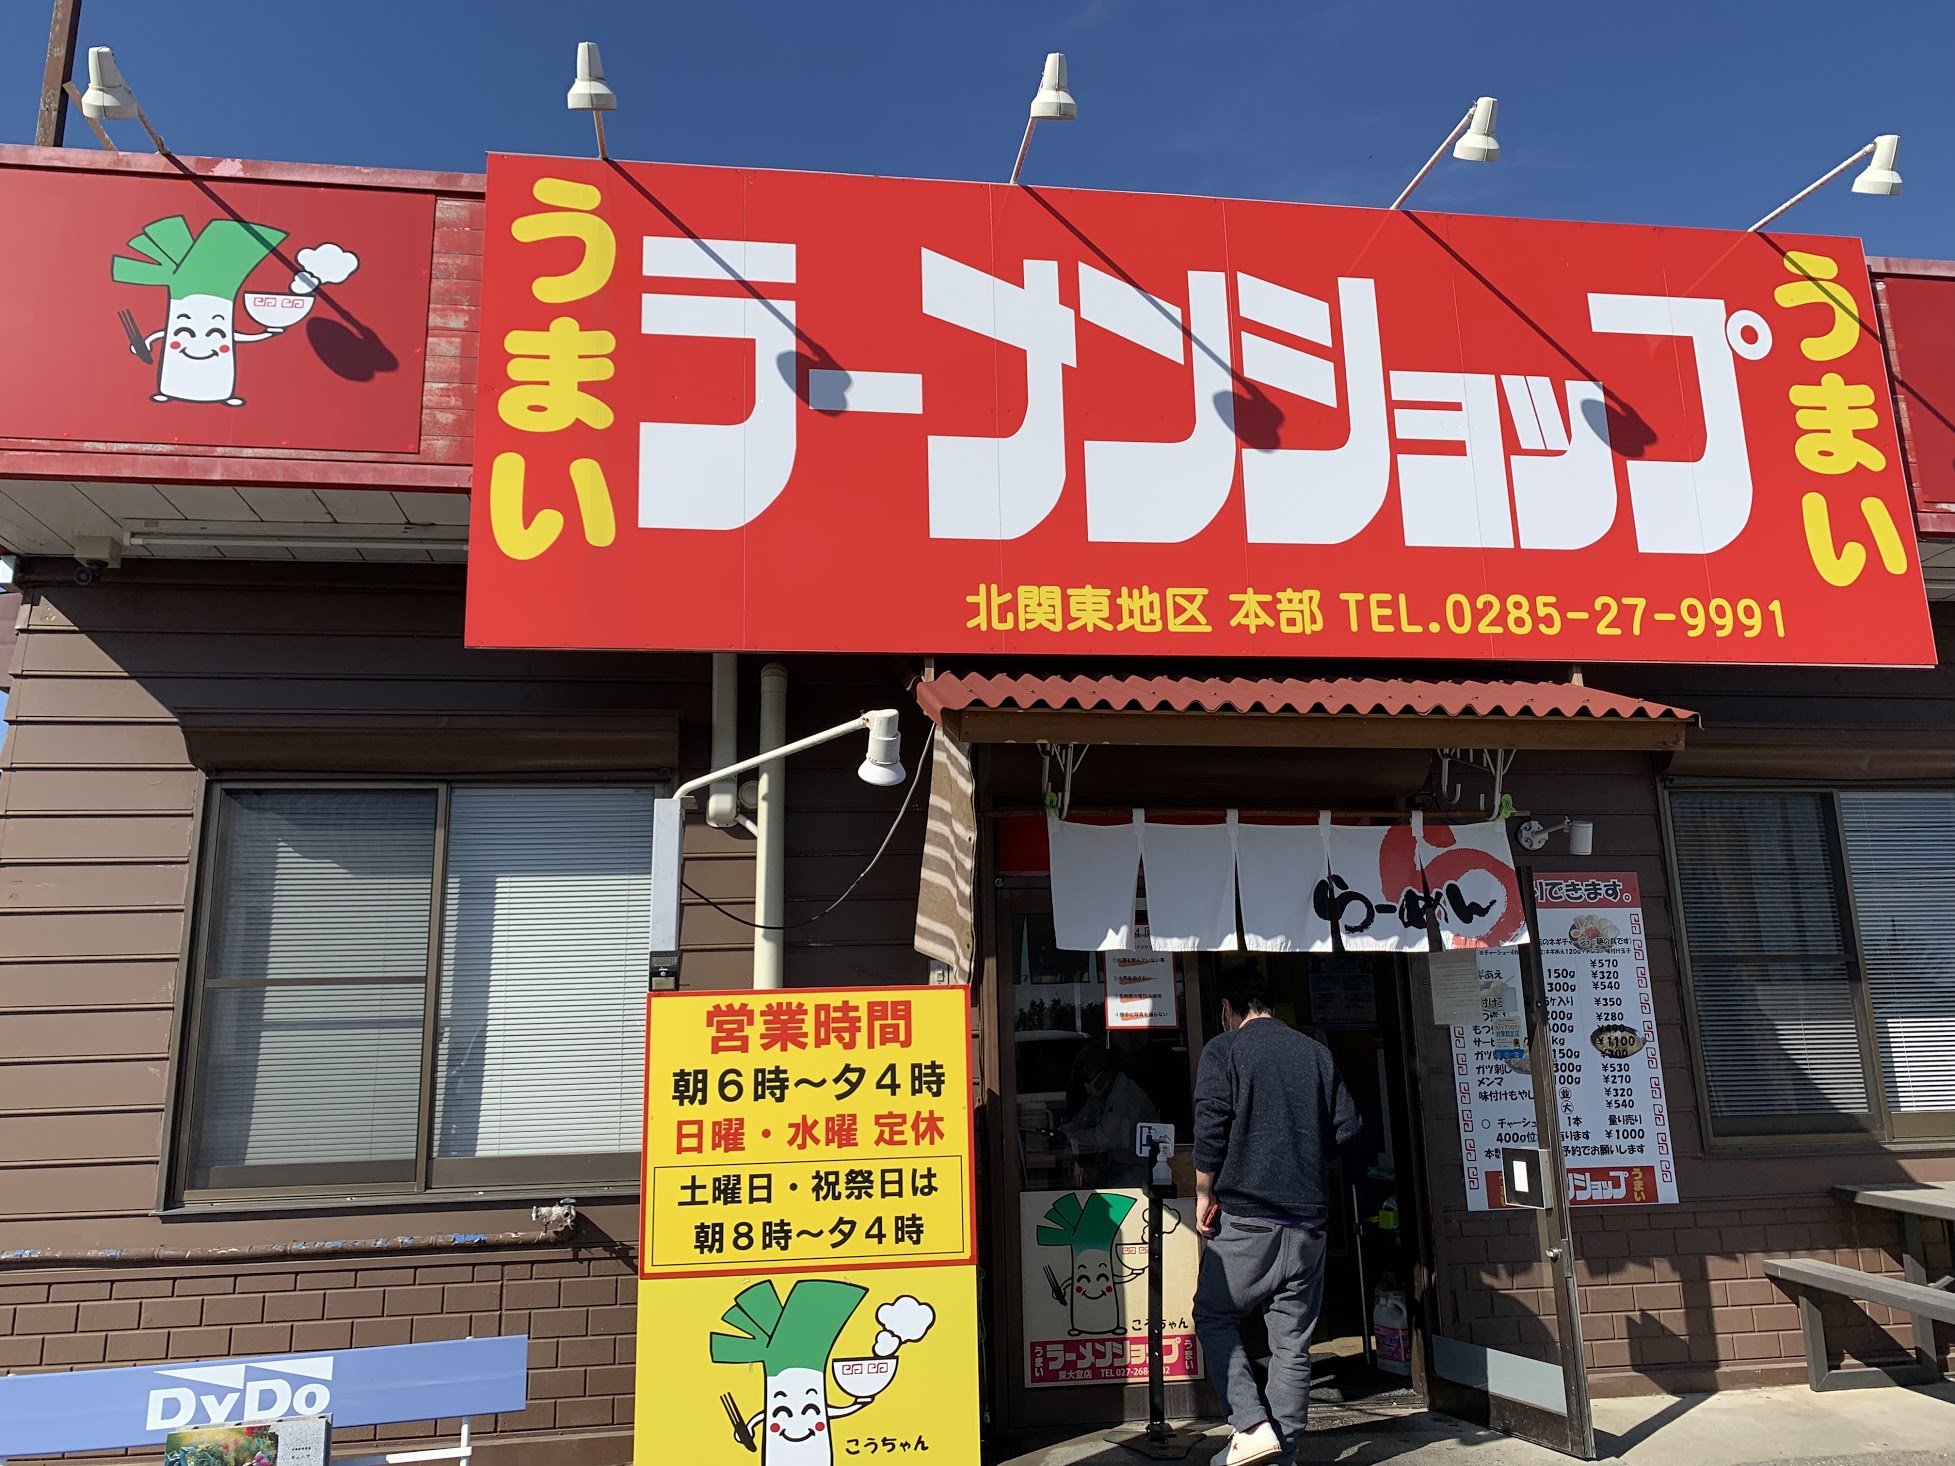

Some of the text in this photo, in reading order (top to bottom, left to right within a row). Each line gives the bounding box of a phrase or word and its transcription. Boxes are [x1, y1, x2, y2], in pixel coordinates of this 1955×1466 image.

[490, 177, 616, 560] うまい
[638, 235, 1773, 555] ラーメンショップ
[1774, 251, 1907, 587] うまい
[965, 583, 1786, 639] 北関東地区 本部 TEL.0285-27-9991
[1590, 959, 1618, 968] ¥570
[1547, 969, 1575, 979] 150g
[1591, 970, 1619, 980] ¥320
[1547, 981, 1620, 992] 300g ¥540
[1594, 997, 1622, 1006] ¥350
[1596, 1012, 1624, 1021] ¥280
[705, 1000, 912, 1054] 営業時間
[1476, 1063, 1630, 1074] ガツ刺し 300g ¥530
[1477, 1077, 1504, 1087] メンマ
[1603, 1075, 1631, 1084] ¥270
[1604, 1088, 1633, 1098] ¥320
[1605, 1099, 1634, 1109] ¥540
[1567, 1116, 1583, 1127] 1本
[1608, 1114, 1642, 1126] 量り売り
[675, 1110, 945, 1155] 日曜・水曜 定休
[1605, 1128, 1645, 1140] ¥1000
[677, 1167, 938, 1207] 土曜日・祝祭日は
[1632, 1168, 1646, 1202] うまい
[1034, 1346, 1044, 1377] うまい
[1184, 1339, 1194, 1370] うまい
[1101, 1368, 1115, 1378] TEL
[146, 1379, 330, 1431] DyDo
[845, 1435, 929, 1455] こうちゃん
